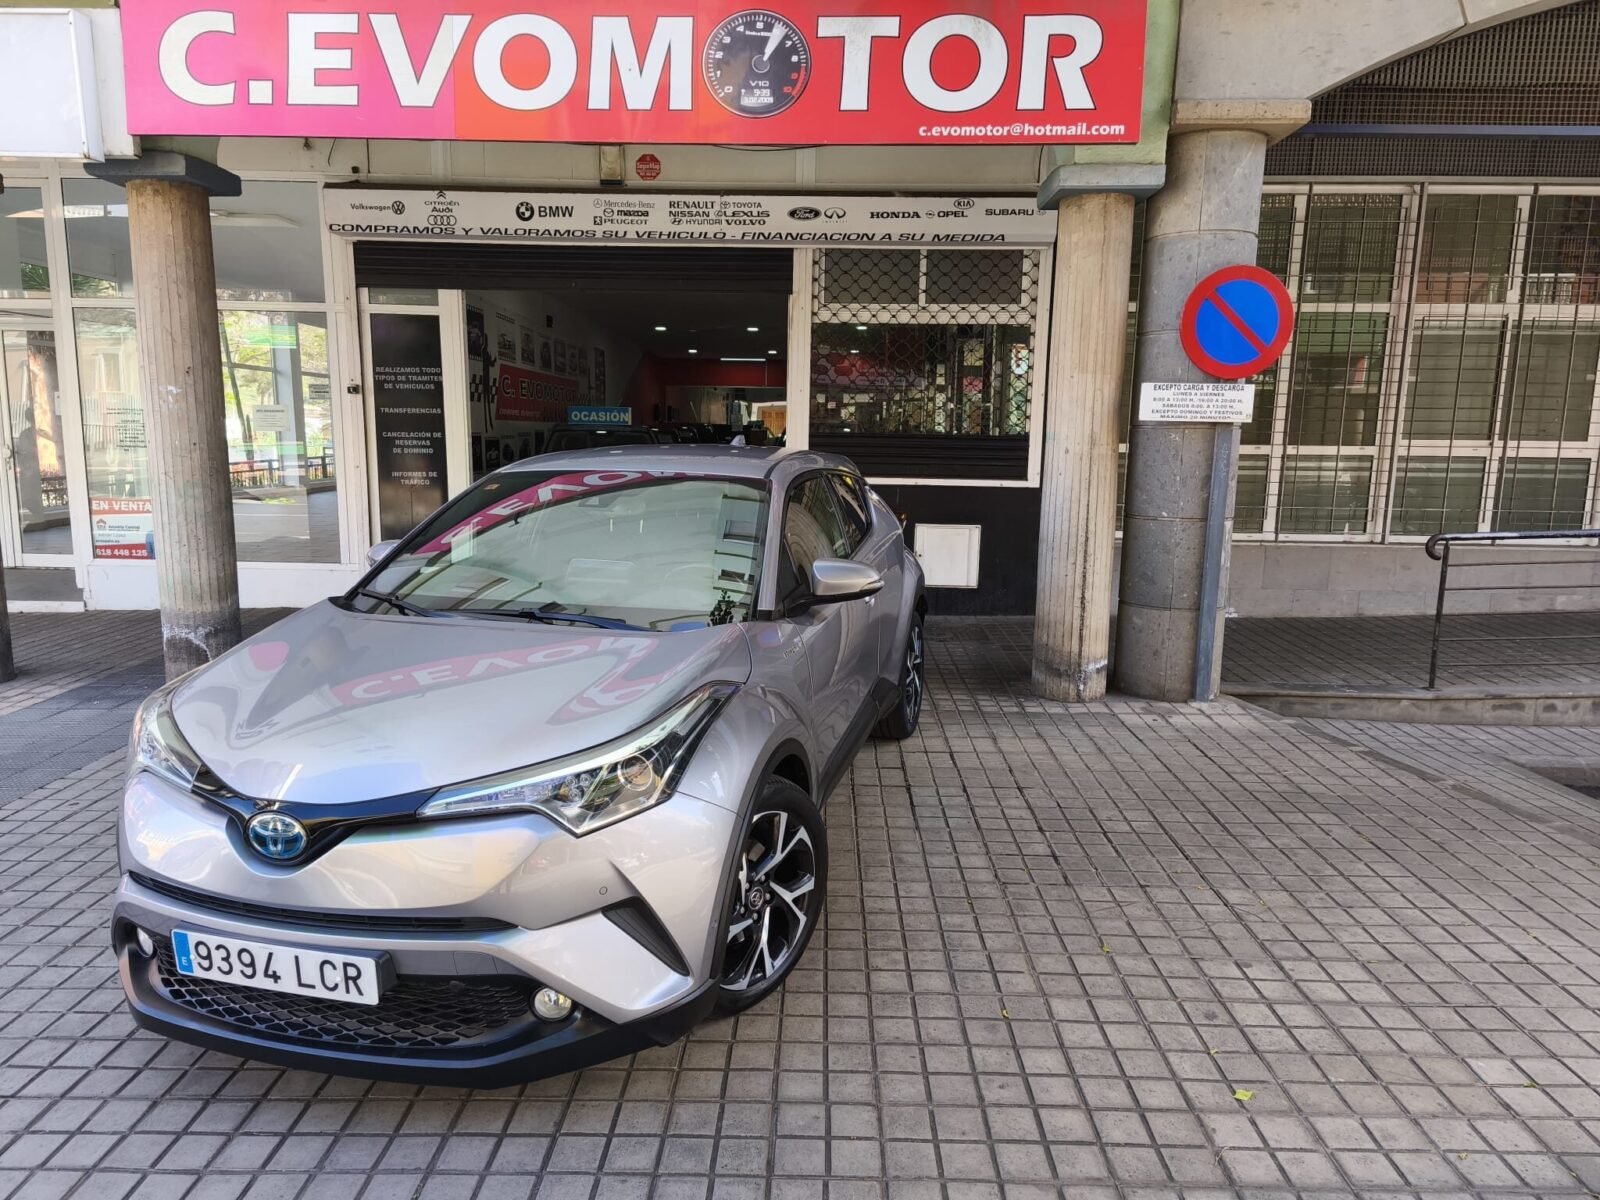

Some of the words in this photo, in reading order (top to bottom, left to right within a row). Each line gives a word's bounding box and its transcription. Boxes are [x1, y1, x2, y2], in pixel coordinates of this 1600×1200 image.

[919, 122, 1125, 136] c.evomotor@hotmail.com
[350, 203, 391, 211] Volkswagen
[603, 200, 655, 209] Mercedes-Benz
[669, 200, 716, 210] RENAULT
[538, 206, 574, 218] BMW
[617, 209, 649, 217] mazda
[669, 210, 710, 218] NISSAN
[870, 211, 921, 219] HONDA
[937, 210, 968, 218] OPEL
[985, 208, 1034, 216] SUBARU
[604, 218, 648, 226] PEUGEOT
[685, 218, 723, 226] HYUNDAI
[329, 223, 455, 235] COMPRAMOS
[462, 227, 473, 236] Y
[480, 227, 596, 238] VALORAMOS
[602, 230, 627, 239] SU
[635, 231, 727, 240] VEHICULO
[741, 232, 875, 242] FINANCIACION
[880, 233, 892, 241] A
[898, 233, 926, 241] SU
[931, 233, 1006, 242] MEDIDA
[571, 409, 629, 422] OCASIÓN
[91, 500, 109, 511] EN
[112, 500, 152, 511] VENTA
[181, 956, 188, 966] E
[193, 940, 281, 984] 9394
[294, 954, 364, 996] LCR
